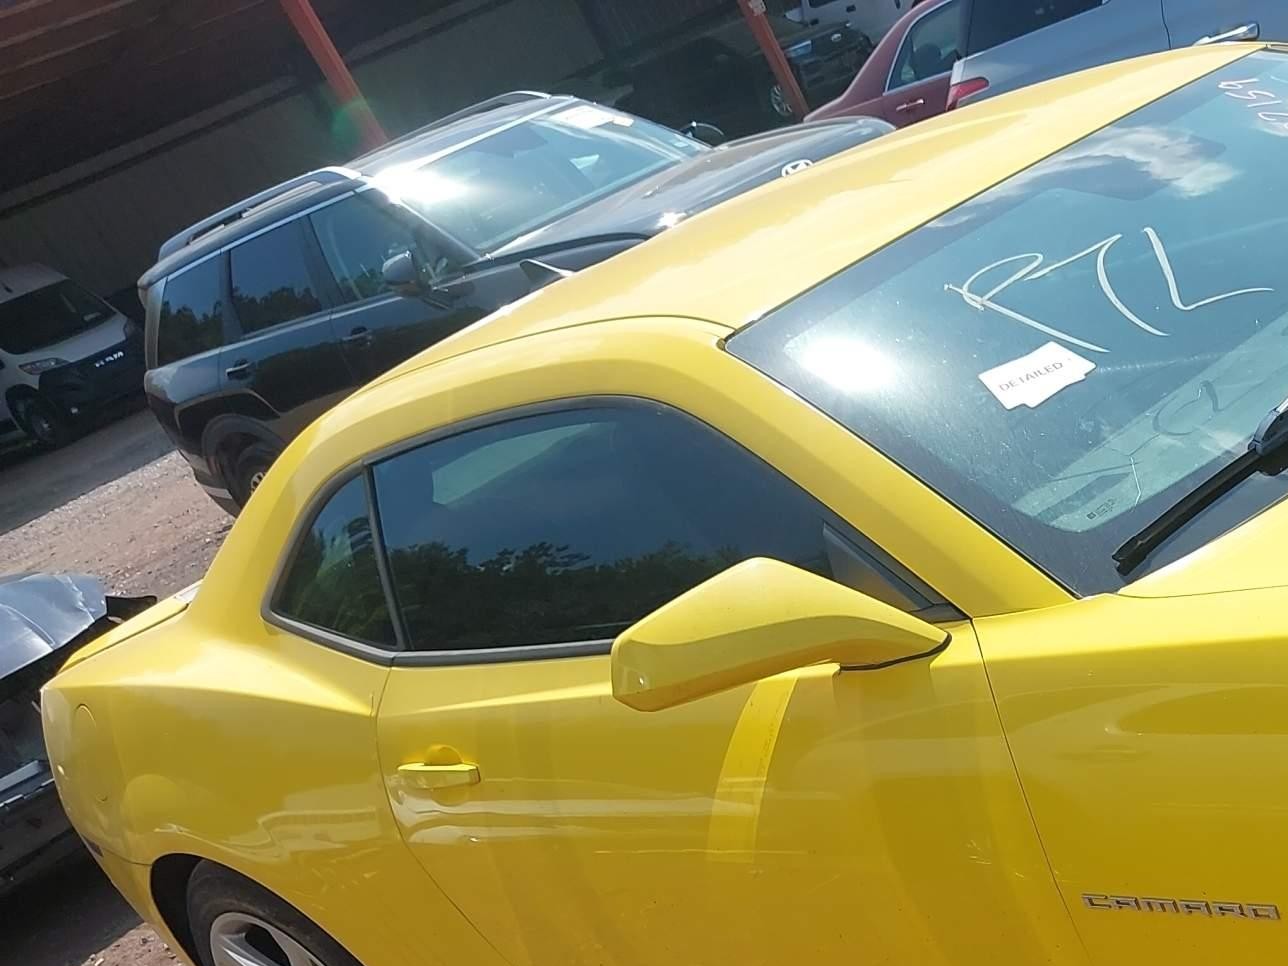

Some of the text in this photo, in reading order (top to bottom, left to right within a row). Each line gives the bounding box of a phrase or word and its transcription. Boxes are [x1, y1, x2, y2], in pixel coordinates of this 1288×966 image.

[943, 226, 1275, 353] RTL
[999, 361, 1064, 392] DETAILED
[1082, 893, 1281, 921] CAMARO
